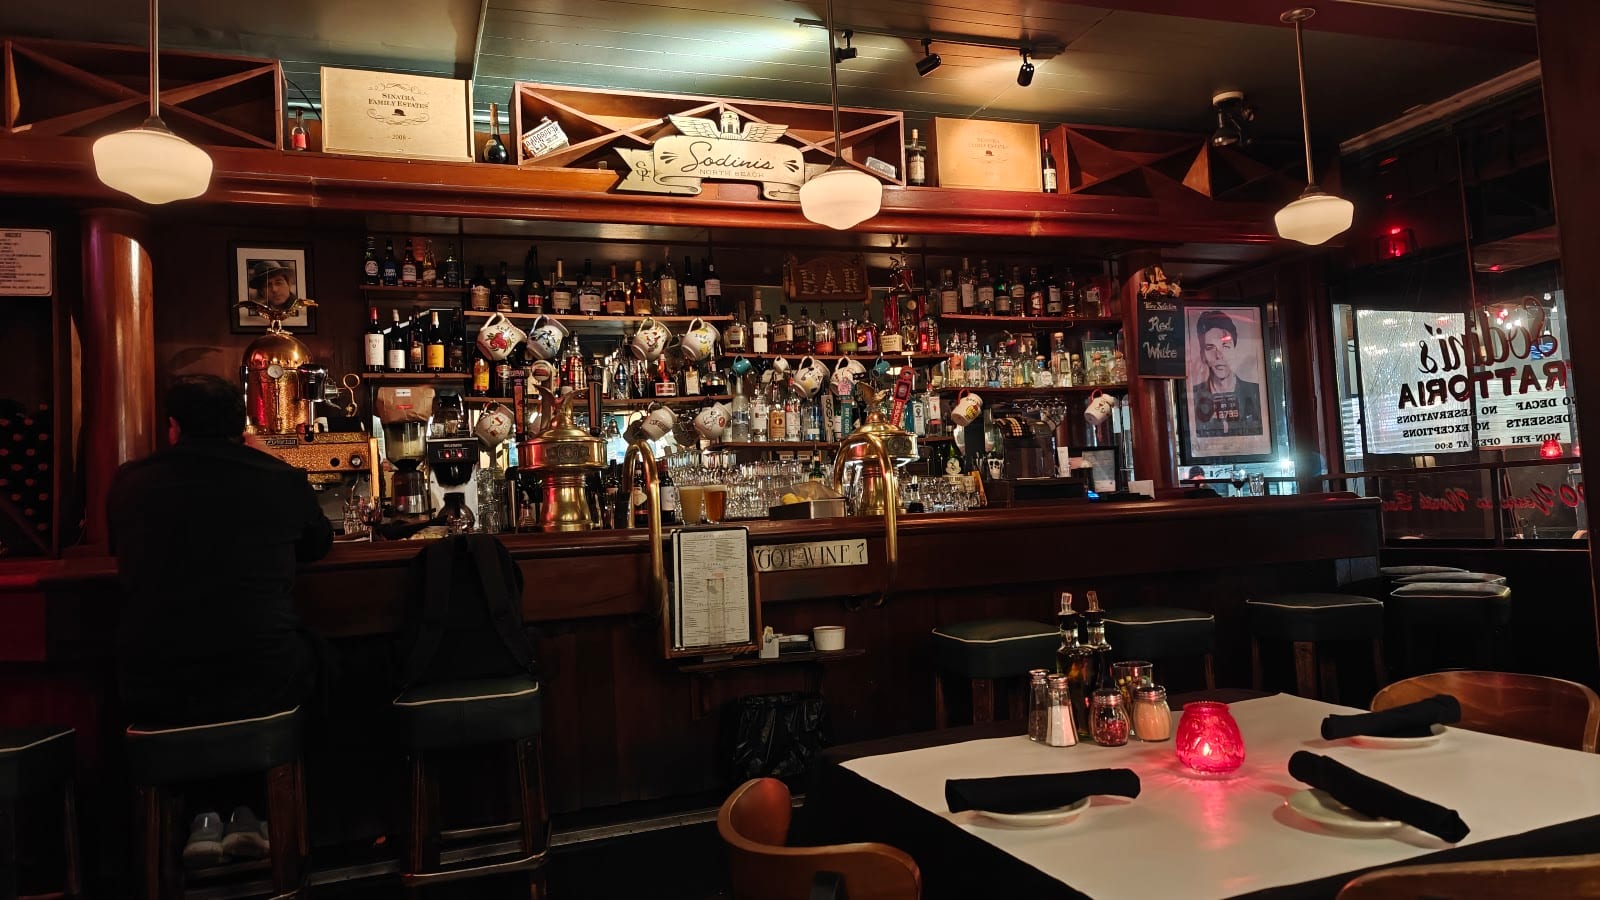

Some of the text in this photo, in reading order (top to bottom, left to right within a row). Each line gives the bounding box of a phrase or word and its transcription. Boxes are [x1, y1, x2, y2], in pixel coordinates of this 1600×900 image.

[368, 98, 429, 109] FAMILY ESTATES
[382, 93, 415, 102] SINATRA
[681, 141, 774, 173] Sodinis
[799, 268, 862, 295] BAR
[1148, 316, 1174, 333] Red
[1157, 333, 1167, 341] or
[1143, 342, 1178, 360] White
[803, 545, 851, 567] WINE
